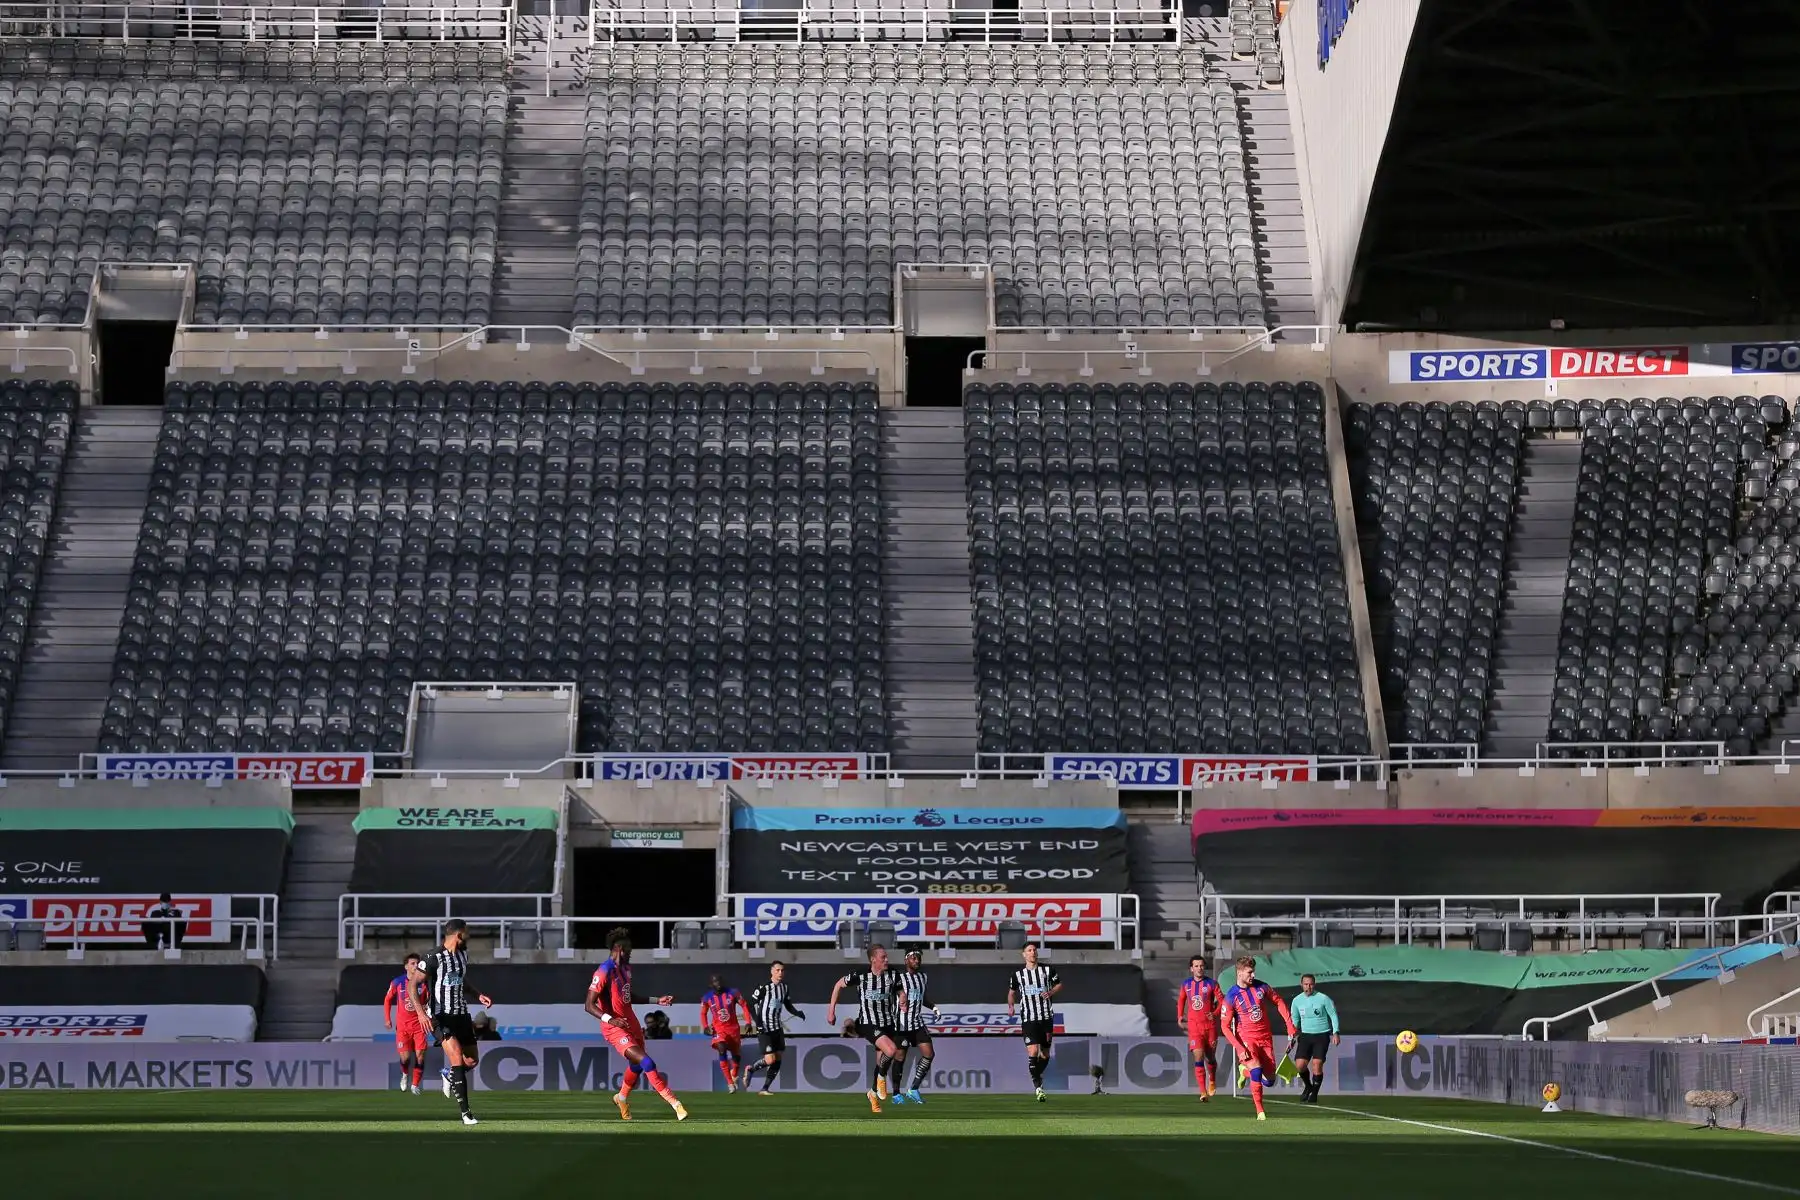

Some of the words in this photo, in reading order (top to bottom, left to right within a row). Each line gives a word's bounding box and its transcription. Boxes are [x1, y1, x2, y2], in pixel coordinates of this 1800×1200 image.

[1418, 353, 1538, 377] SPORTS
[1558, 350, 1680, 375] DIRECT
[114, 760, 227, 780] SPORTS
[247, 760, 357, 782] DIRECT
[610, 760, 722, 780] SPORTS
[741, 761, 850, 780] DIRECT
[1060, 760, 1172, 783] SPORTS
[1191, 762, 1302, 782] DIRECT
[399, 808, 440, 818] WE
[445, 808, 494, 818] ARE
[397, 818, 449, 827] ONE
[455, 818, 526, 827] TEAM
[815, 813, 905, 825] Premier
[954, 813, 1045, 827] League
[613, 830, 662, 840] Emergency
[663, 830, 680, 839] exit
[780, 841, 948, 853] NEWCASTLE
[956, 840, 1031, 851] WEST
[1040, 839, 1100, 851] END
[856, 855, 1018, 866] FOODBANK
[14, 861, 82, 873] ONE
[781, 869, 857, 881] TEXT
[876, 884, 919, 895] TO
[927, 883, 1009, 894] 88802
[755, 901, 910, 932] SPORTS
[937, 902, 1090, 932] DIRECT
[1370, 967, 1422, 975] League
[1535, 970, 1556, 979] WE
[1559, 969, 1586, 978] ARE
[1587, 967, 1614, 976] ONE
[1615, 966, 1651, 975] TEAM
[0, 1015, 137, 1027] SPORTS
[87, 1059, 253, 1089] MARKETS
[264, 1058, 356, 1088] WITH
